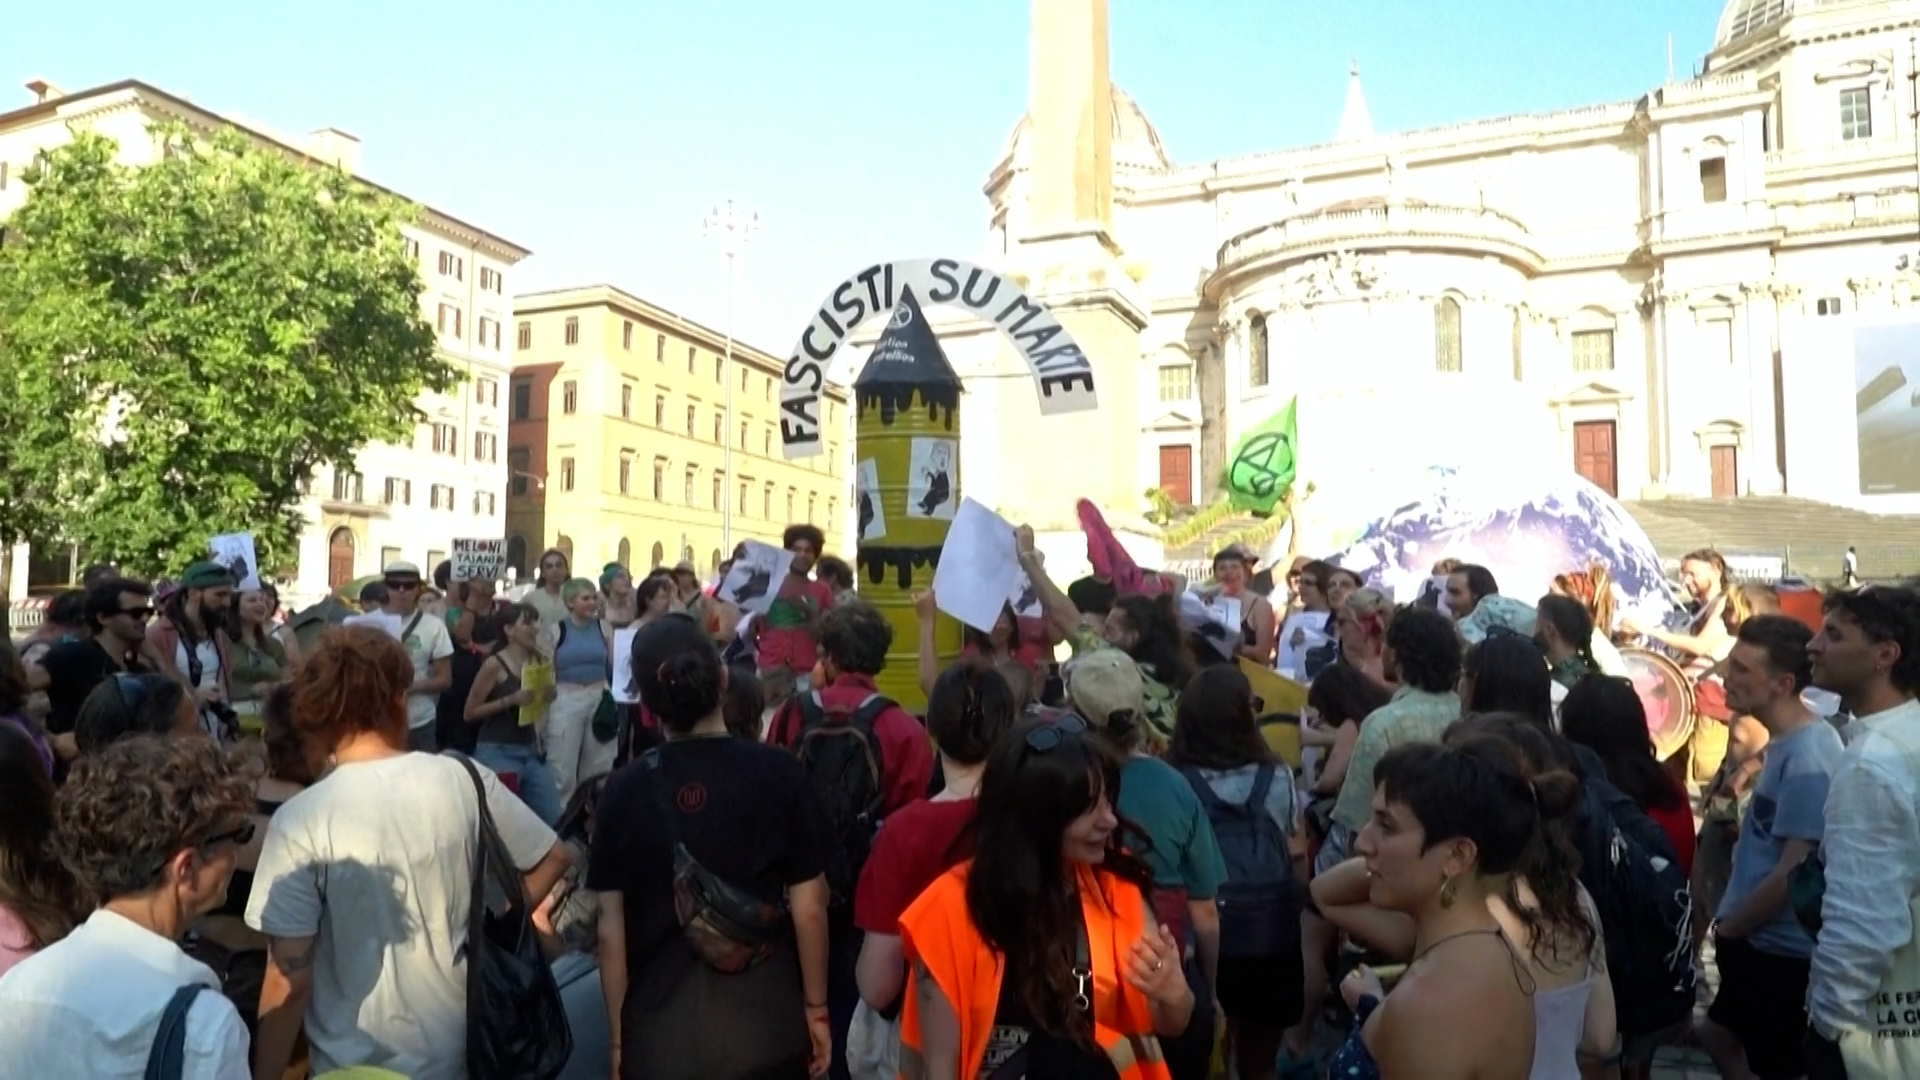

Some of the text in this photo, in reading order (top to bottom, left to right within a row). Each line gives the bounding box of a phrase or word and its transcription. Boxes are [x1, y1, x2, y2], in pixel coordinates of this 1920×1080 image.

[781, 258, 1094, 445] FASCISTI SU MARTE
[453, 538, 501, 554] MELONI
[456, 565, 499, 578] SERVI
[1877, 1009, 1898, 1025] LA
